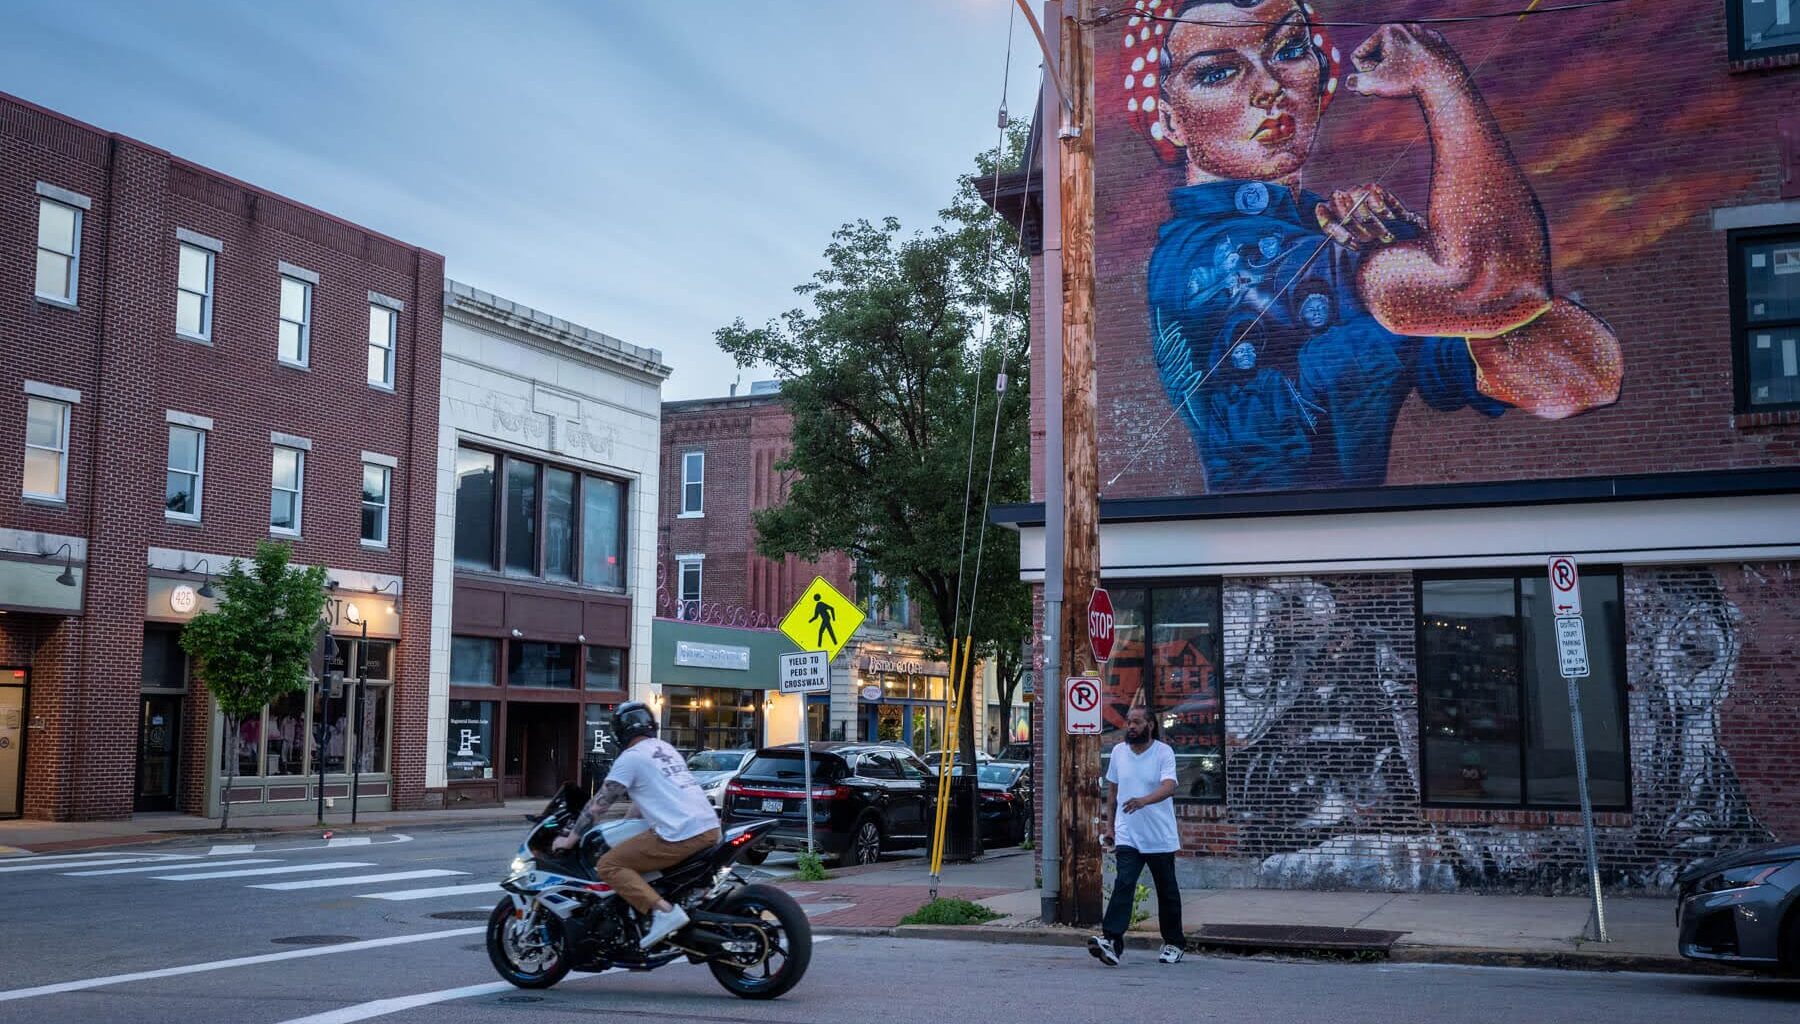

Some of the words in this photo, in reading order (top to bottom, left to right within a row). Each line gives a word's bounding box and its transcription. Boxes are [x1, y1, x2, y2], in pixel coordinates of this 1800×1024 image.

[1090, 611, 1113, 639] STOP
[789, 657, 807, 666] YIELD
[810, 656, 819, 664] TO
[791, 668, 808, 677] PEDS
[811, 667, 818, 675] IN
[784, 678, 825, 688] CROSSWALK
